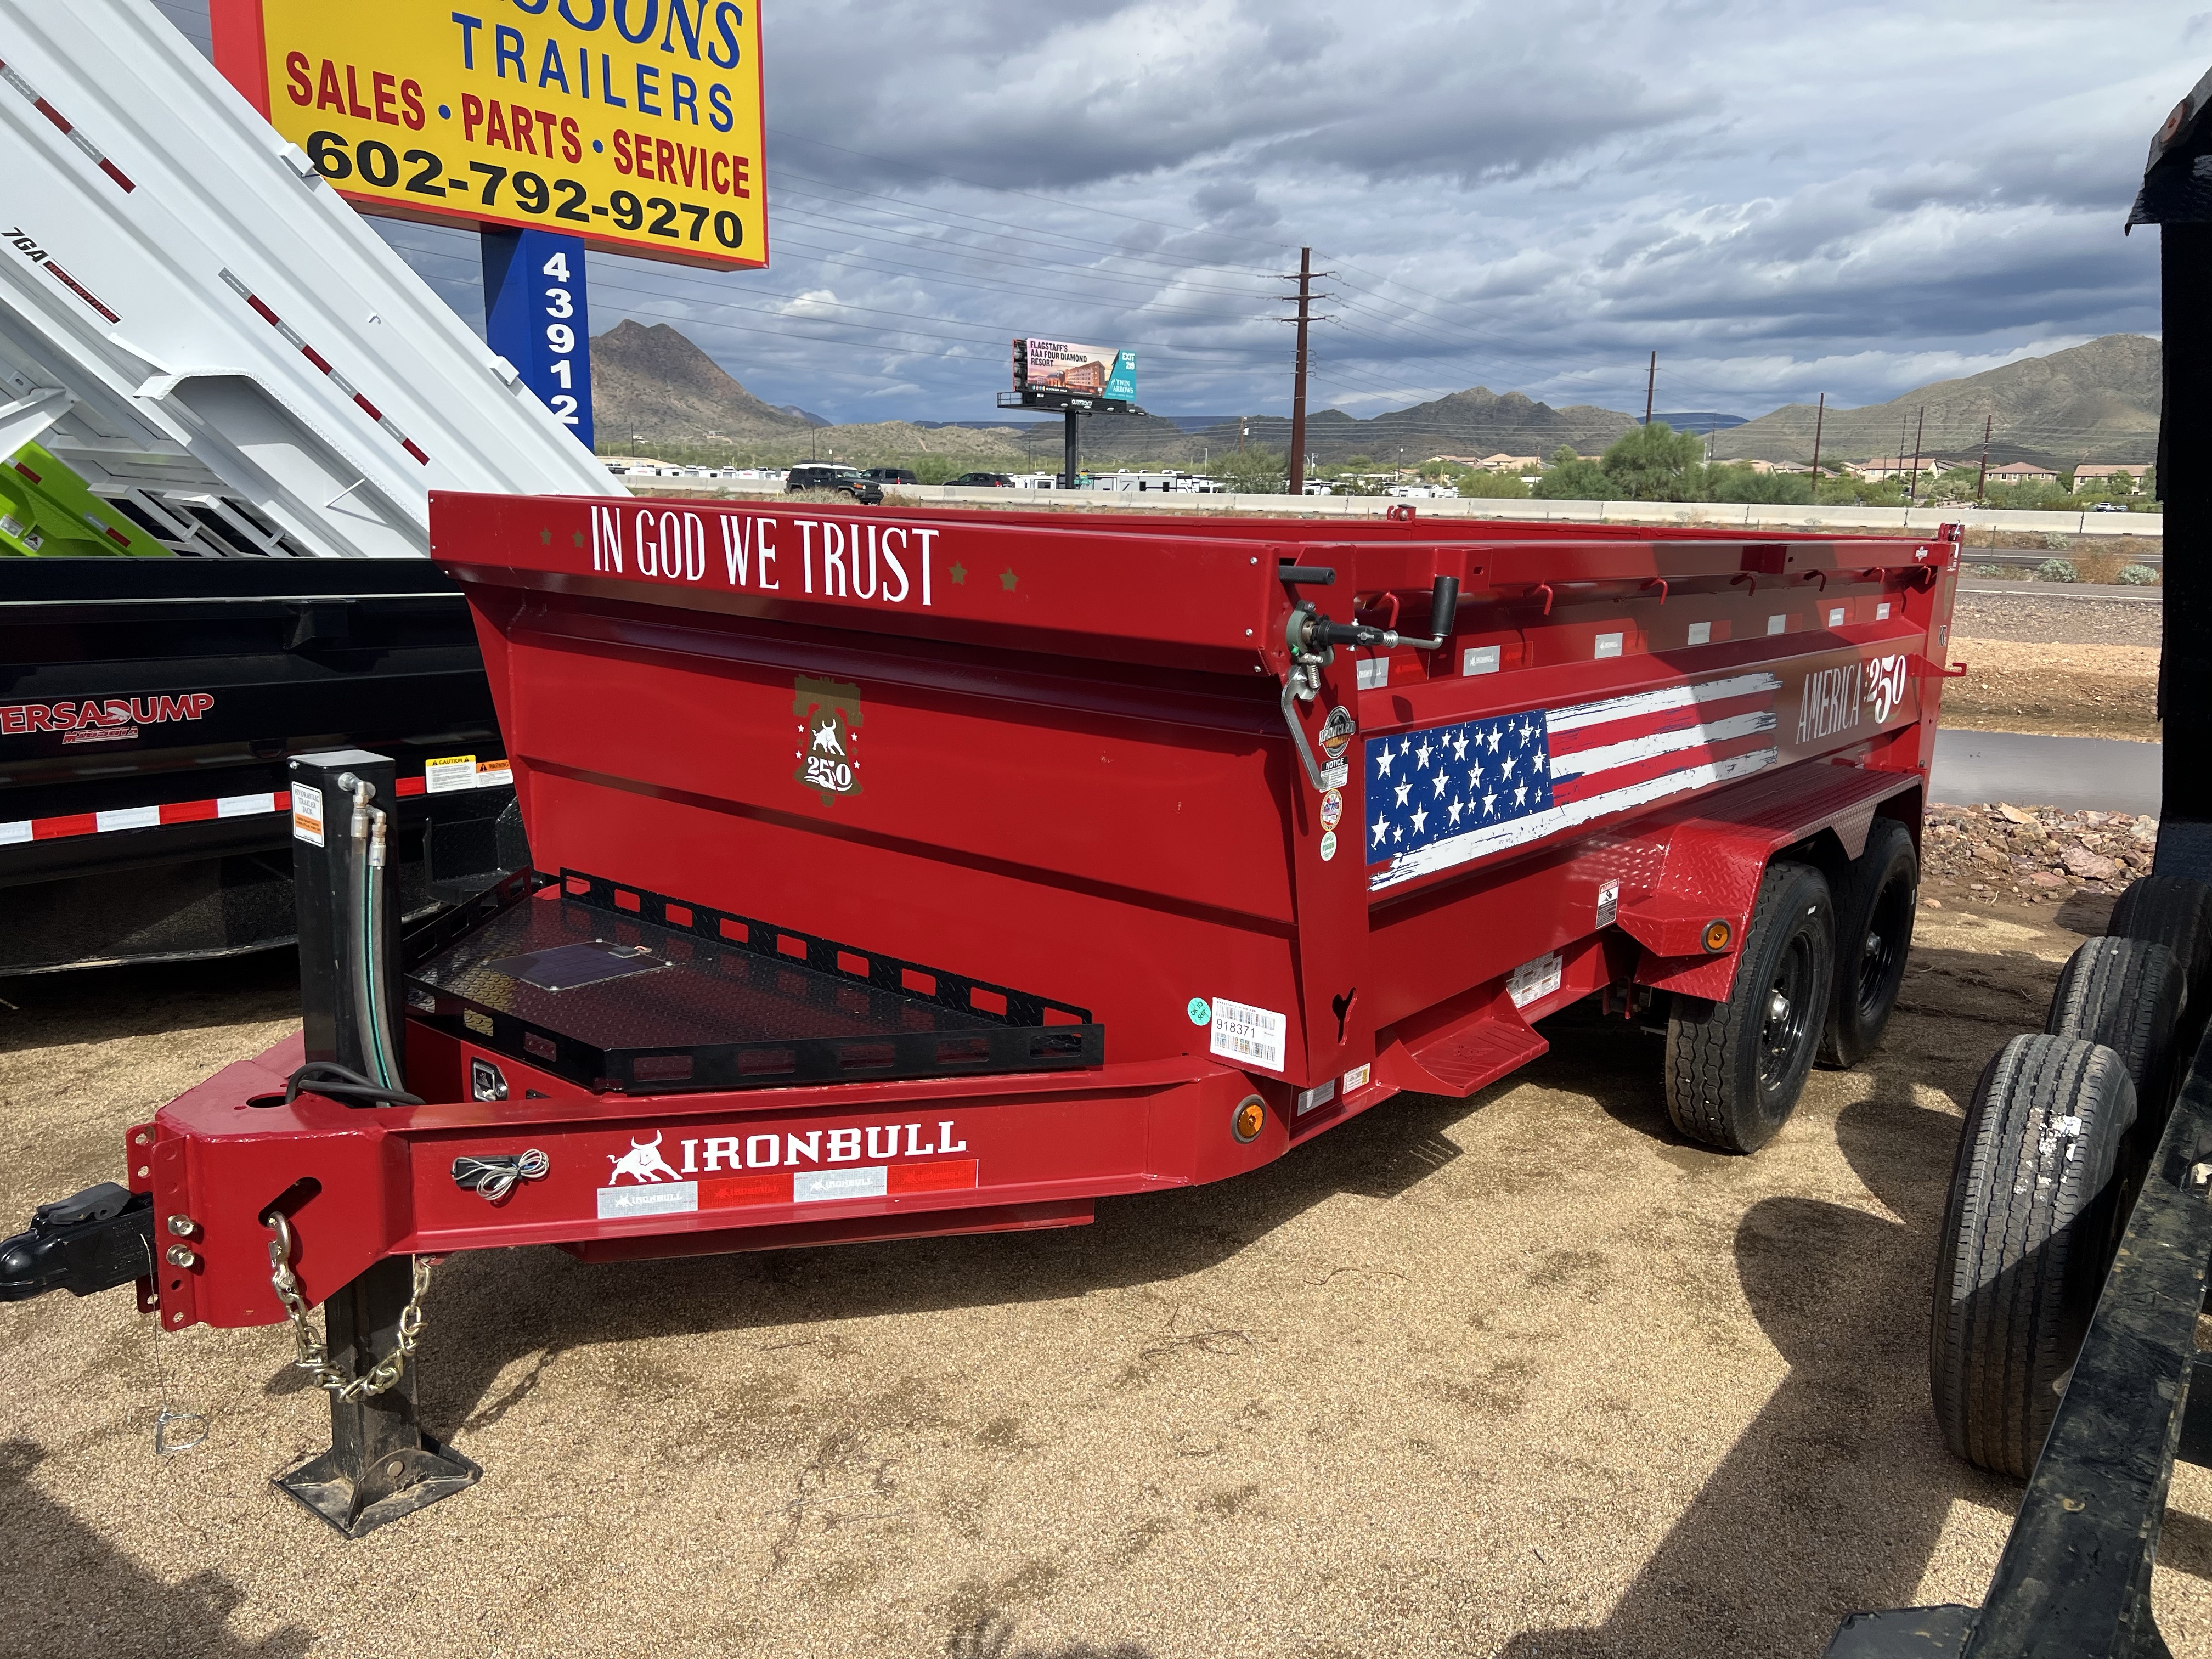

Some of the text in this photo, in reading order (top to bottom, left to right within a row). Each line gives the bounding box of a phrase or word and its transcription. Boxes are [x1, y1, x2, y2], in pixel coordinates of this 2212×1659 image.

[512, 0, 743, 70] ONS
[451, 12, 733, 133] TRAILERS
[286, 50, 751, 199] SALES PARTS SERVICE
[307, 130, 743, 249] 602-792-9270
[1, 227, 49, 263] 7GA
[47, 263, 117, 321] HEAVY DUTY FLOOR
[543, 252, 579, 425] 43912
[1030, 340, 1068, 352] FLAGSTAFF'S
[1031, 349, 1087, 363] AAA FOUR DIAMOND
[1031, 357, 1054, 367] RESORT
[1122, 352, 1135, 362] EXIT
[1113, 385, 1133, 394] ARROWS
[1116, 379, 1130, 387] TWIN
[590, 505, 940, 606] IN GOD WE TRUST
[1796, 654, 1906, 744] AMERICA 250
[0, 693, 215, 735] ERSADUMP
[1320, 722, 1355, 743] IRONCLAD
[1325, 758, 1344, 769] NOTICE
[806, 755, 852, 790] 250
[295, 789, 319, 802] HYDRAULIC
[298, 797, 316, 809] TRAILER
[302, 806, 313, 815] JACK
[1604, 880, 1618, 891] DANGER
[1190, 1007, 1198, 1015] OK
[1197, 1009, 1206, 1020] SHIP
[1216, 1018, 1255, 1039] 918371
[680, 1121, 967, 1174] IRONBULL
[825, 1178, 873, 1189] IRONBULL
